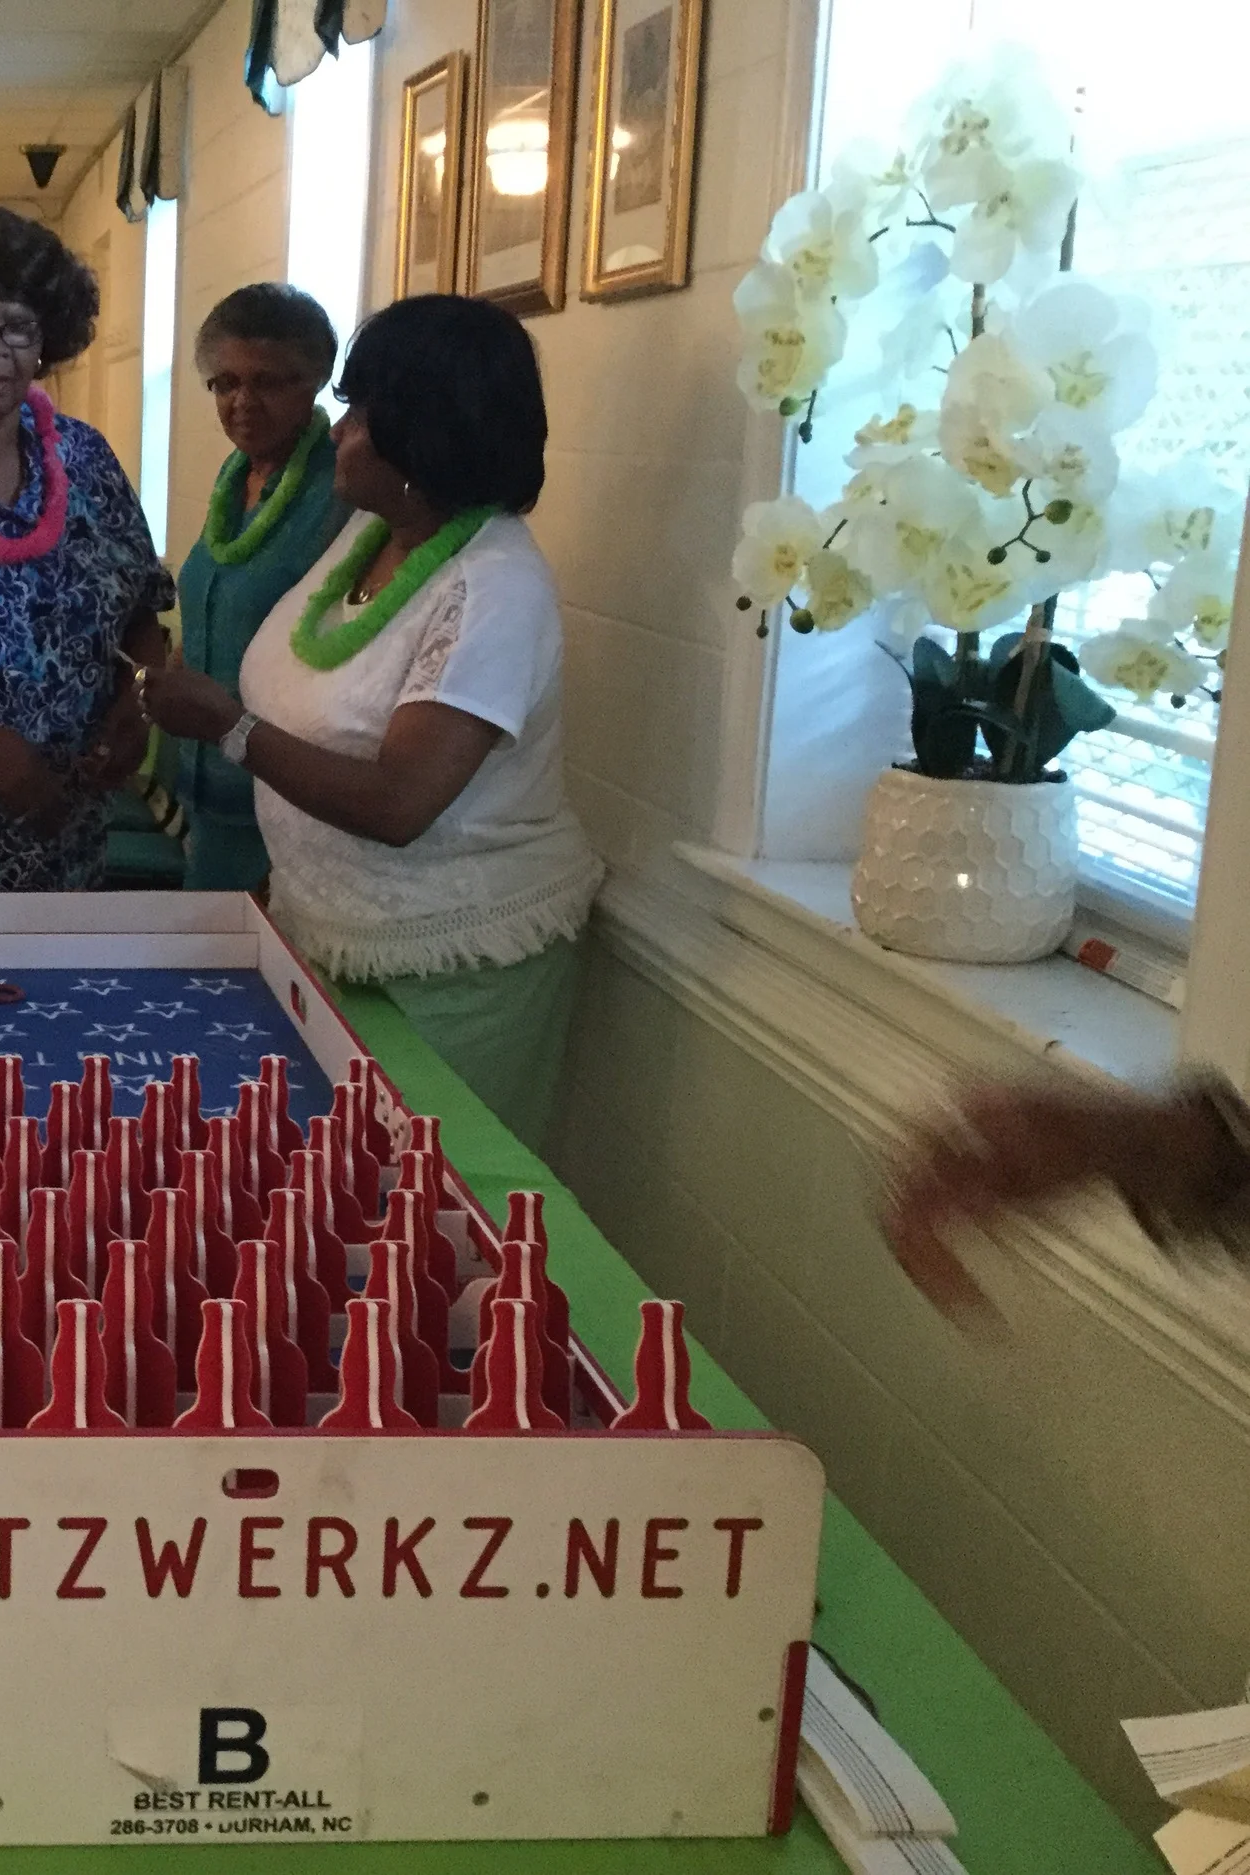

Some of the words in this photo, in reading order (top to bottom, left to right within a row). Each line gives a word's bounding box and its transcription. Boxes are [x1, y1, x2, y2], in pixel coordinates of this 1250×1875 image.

[198, 1707, 270, 1785] B
[133, 1791, 201, 1811] BEST
[208, 1790, 332, 1809] RENT-ALL
[110, 1818, 199, 1835] 286-3708
[322, 1816, 352, 1832] NC
